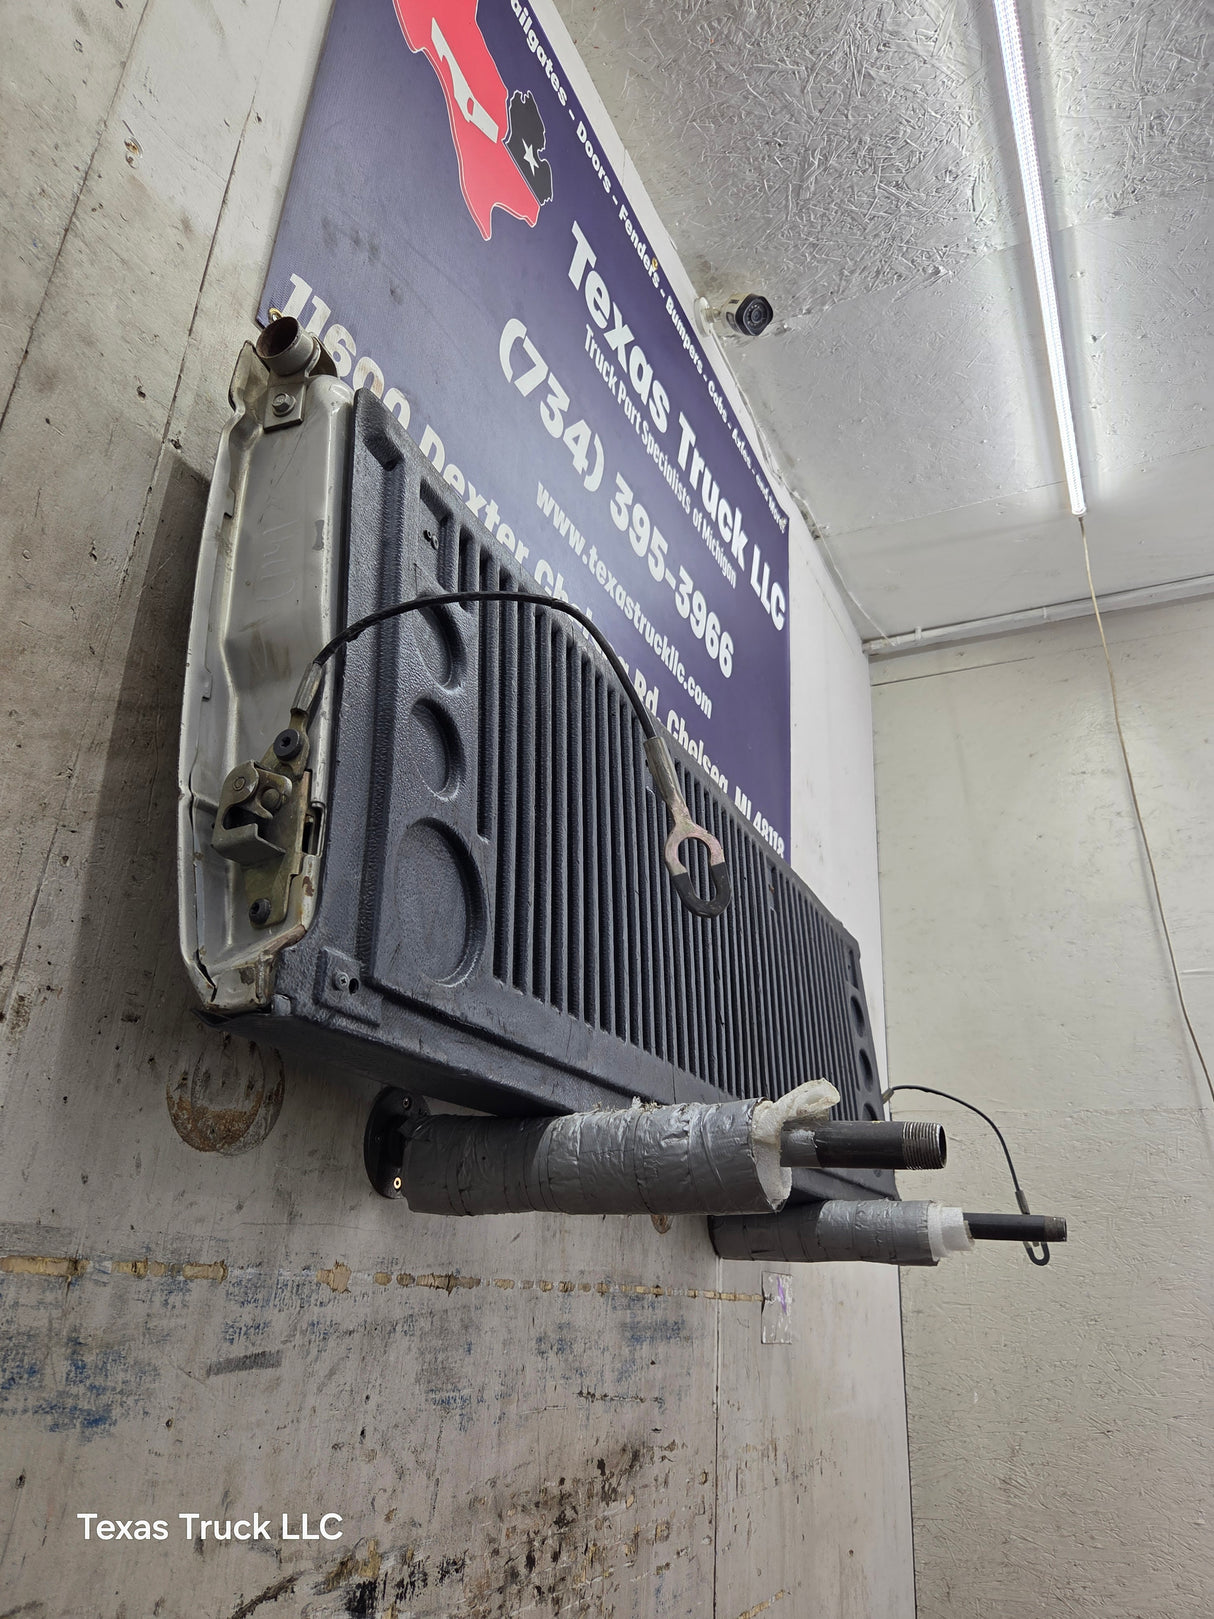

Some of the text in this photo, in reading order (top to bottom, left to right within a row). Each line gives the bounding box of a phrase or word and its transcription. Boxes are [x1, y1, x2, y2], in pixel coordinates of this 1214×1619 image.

[568, 220, 786, 631] Texas Truck LLC
[576, 121, 611, 193] Doors
[618, 204, 660, 288] Fenders
[665, 296, 703, 374] Bumpers
[708, 380, 727, 423] Cabs
[731, 428, 752, 469] Axles
[585, 323, 737, 589] Truck Part Specialists of Michigan
[418, 424, 530, 563] Dexter
[734, 785, 752, 821] MI
[499, 318, 605, 492] (734)
[609, 471, 734, 678] 395-3966
[536, 481, 713, 719] www.texastruckllc.com
